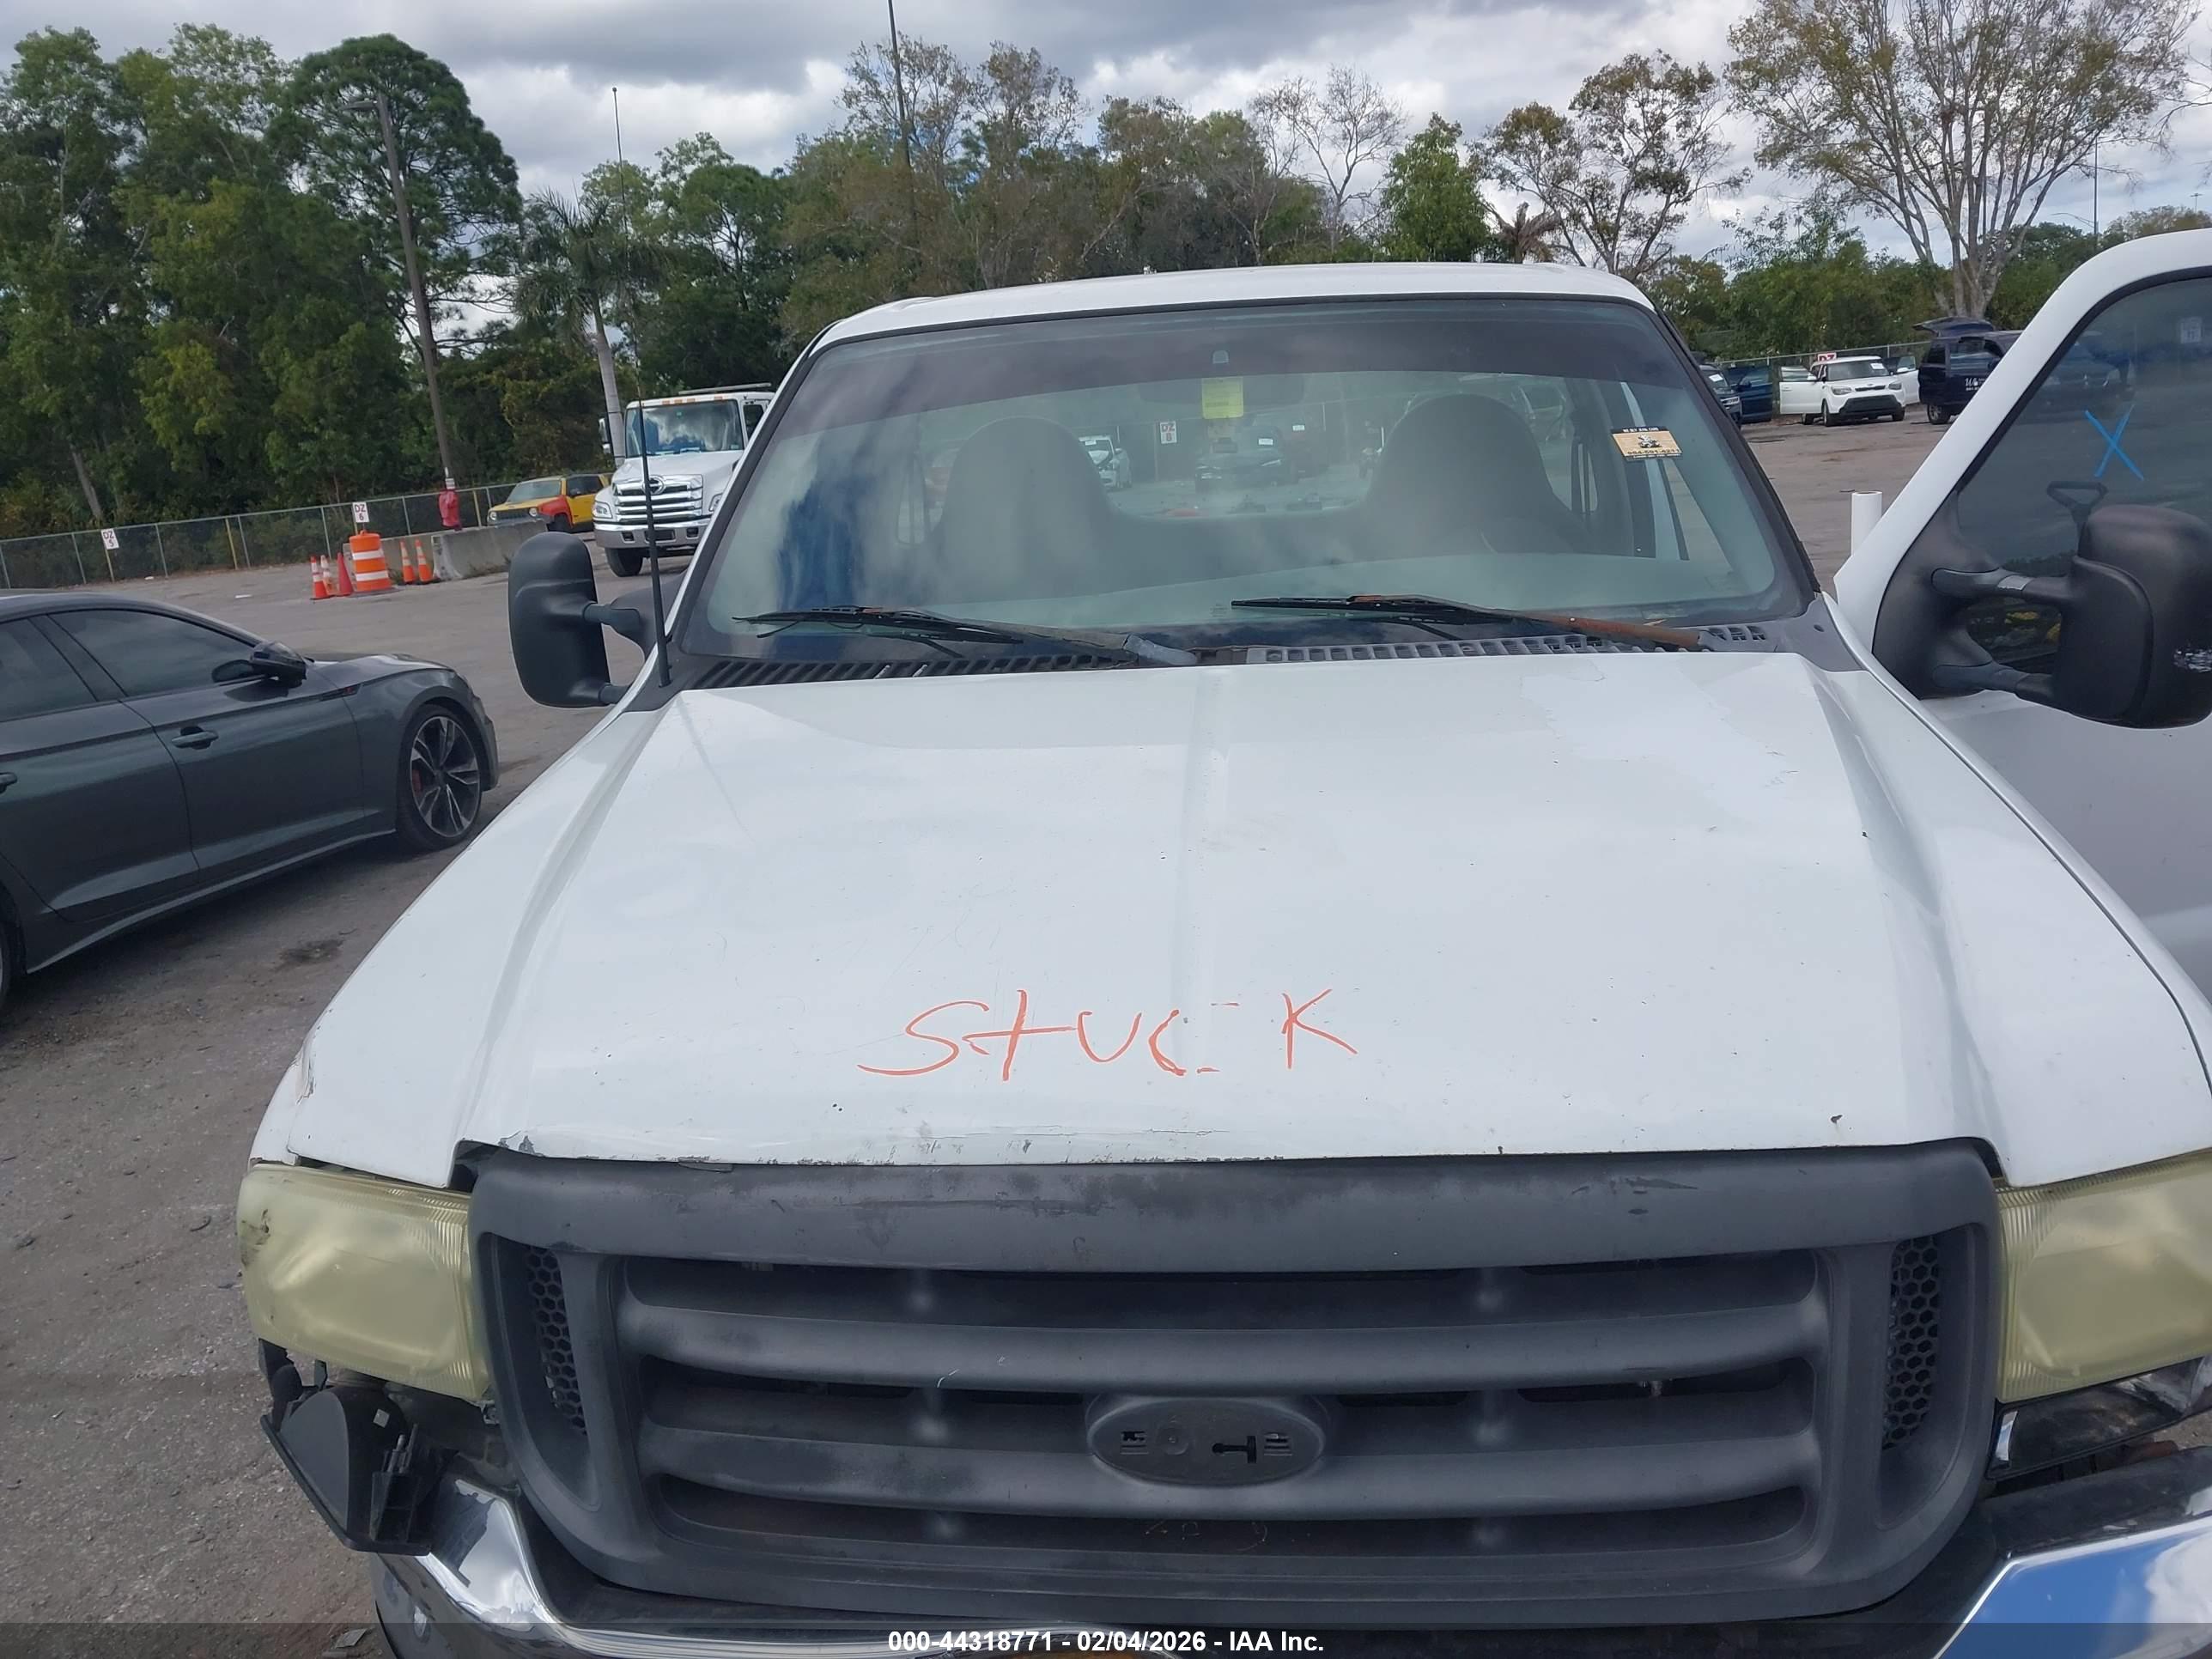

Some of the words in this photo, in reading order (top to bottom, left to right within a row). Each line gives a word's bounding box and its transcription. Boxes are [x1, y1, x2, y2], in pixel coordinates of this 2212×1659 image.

[1160, 422, 1176, 432] DZ
[355, 504, 367, 513] DZ
[103, 530, 114, 539] DZ
